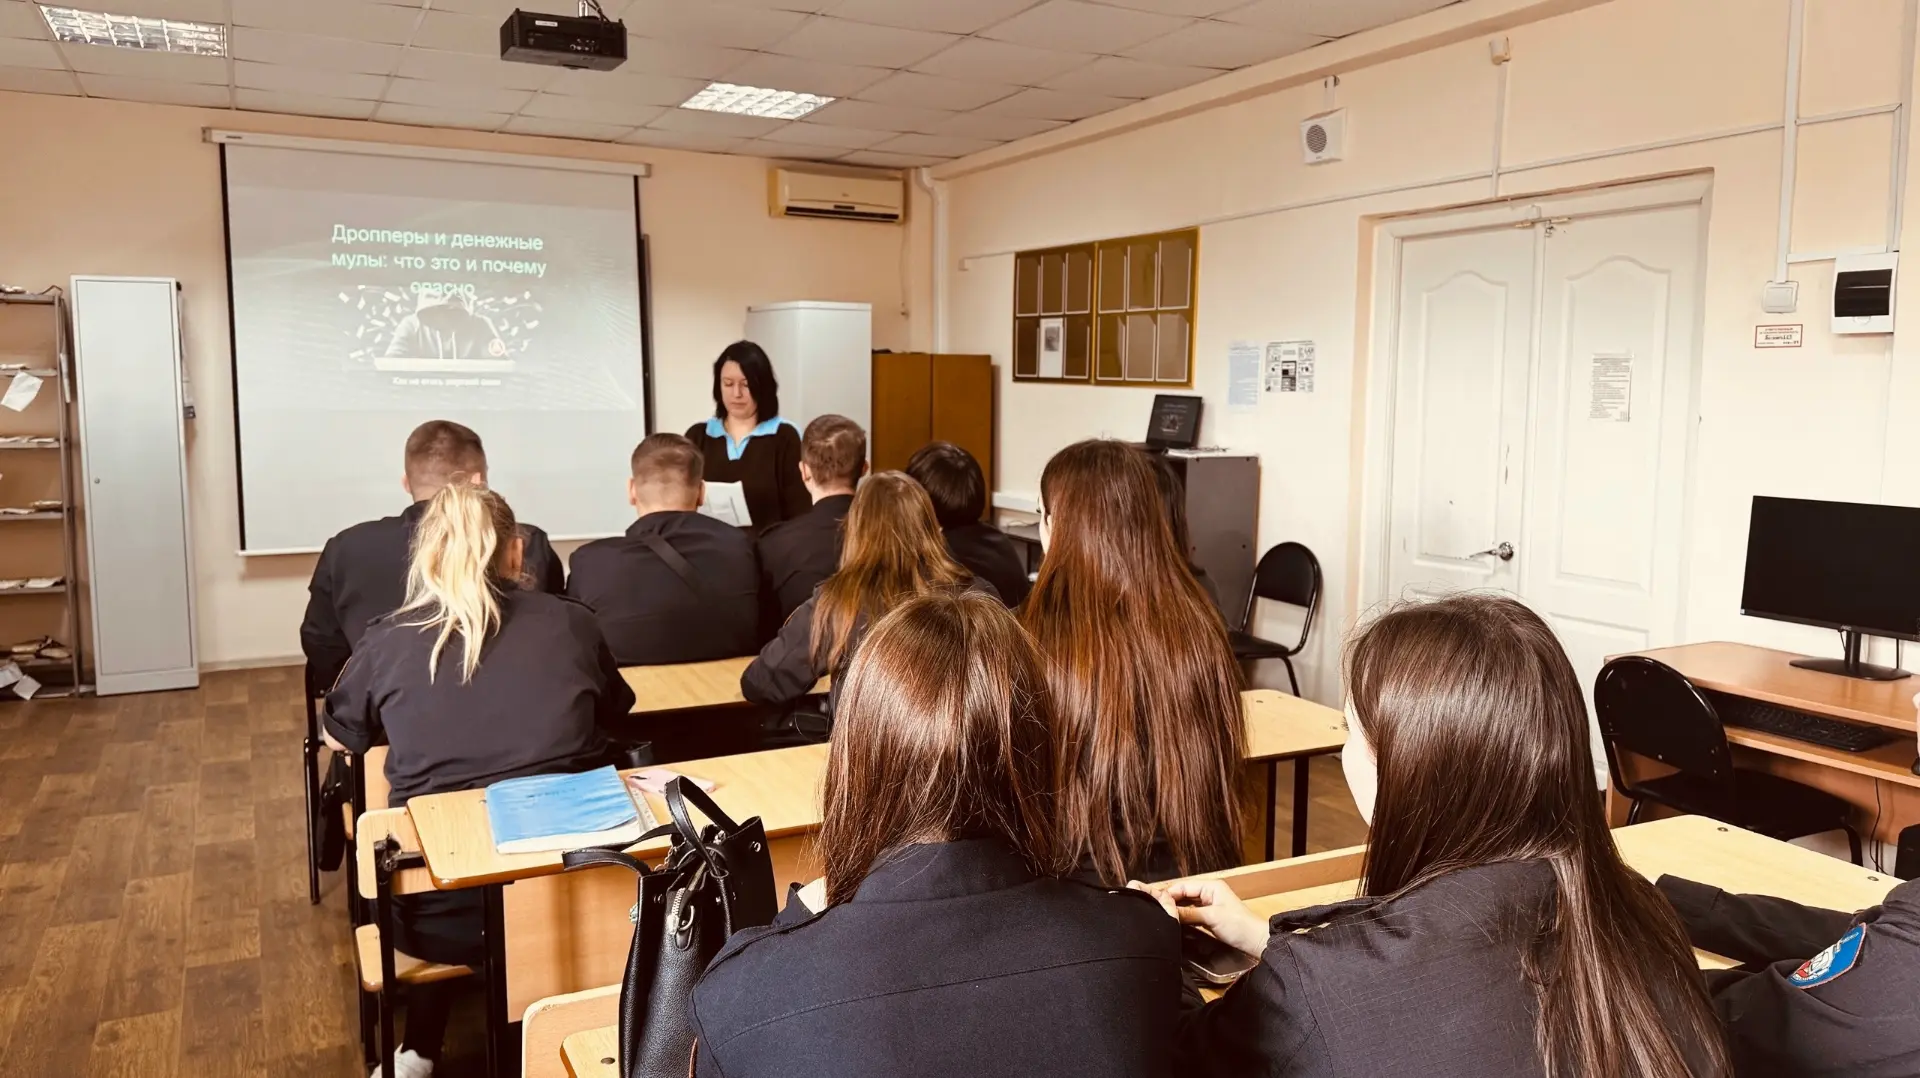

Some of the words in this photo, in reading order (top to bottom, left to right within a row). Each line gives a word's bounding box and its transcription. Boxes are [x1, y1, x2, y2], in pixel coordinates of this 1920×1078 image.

[331, 224, 429, 247] Дропперы
[434, 233, 446, 246] и
[450, 234, 544, 251] денежные
[331, 252, 388, 270] мулы:
[393, 256, 425, 269] что
[430, 257, 461, 271] это
[466, 259, 478, 272] и
[482, 260, 547, 278] почему
